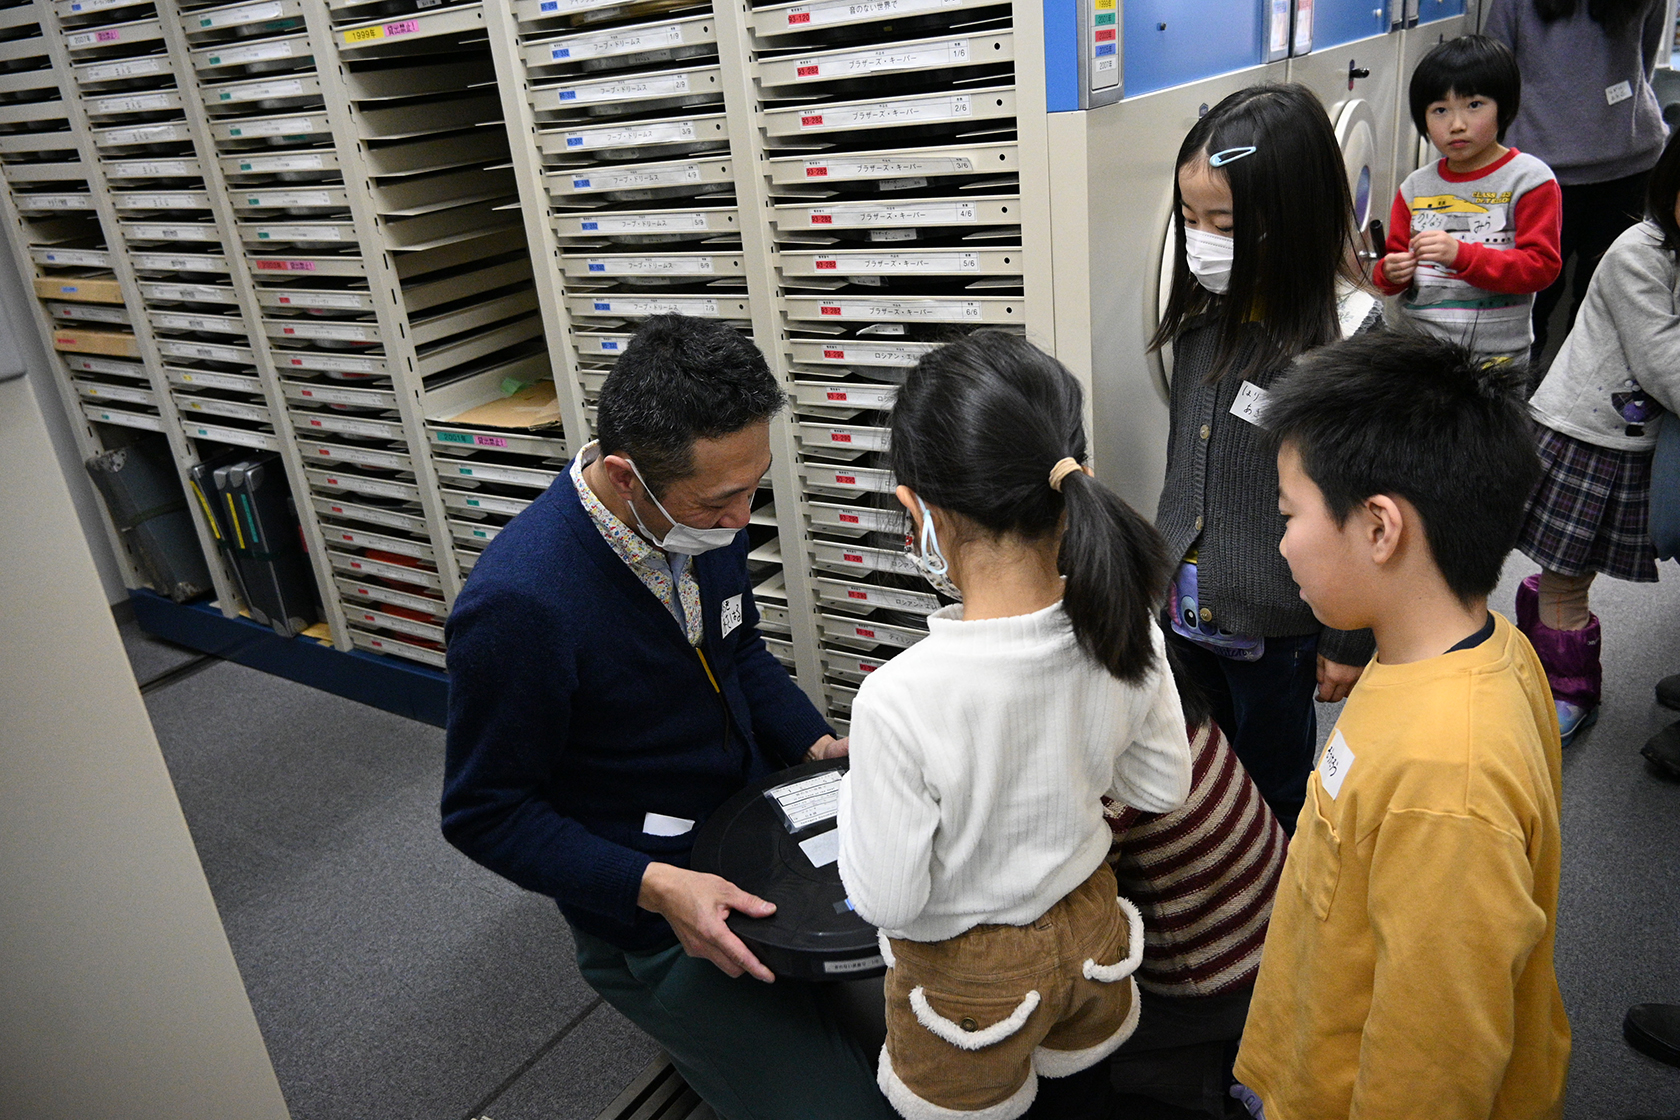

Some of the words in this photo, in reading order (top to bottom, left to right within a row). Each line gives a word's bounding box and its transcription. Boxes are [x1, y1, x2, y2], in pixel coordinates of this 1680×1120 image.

[788, 12, 810, 25] 93-120
[849, 1, 898, 15] 音のない世界で
[74, 35, 91, 44] 2007年
[352, 29, 376, 40] 1999年
[797, 66, 819, 77] 93-282
[848, 55, 917, 69] ブラザーズ・キーパー
[953, 49, 966, 57] 1/6
[1100, 60, 1113, 70] 2007年
[801, 115, 823, 126] 93-282
[852, 109, 920, 121] ブラザーズ・キーパー
[954, 104, 967, 112] 2/6
[806, 167, 828, 177] 93-282
[857, 163, 923, 173] ブラザーズ・キーパー
[956, 162, 969, 170] 3/6
[811, 215, 832, 224] 93-282
[860, 212, 926, 221] ブラザーズ・キーパー
[960, 210, 972, 218] 4/6
[815, 261, 837, 269] 93-282
[865, 260, 929, 268] ブラザーズ・キーパー
[821, 307, 841, 315] 93-282
[869, 308, 933, 316] ブラザーズ・キーパー
[966, 308, 978, 316] 6/6
[824, 350, 844, 359] 93-290
[444, 433, 466, 443] 2001年
